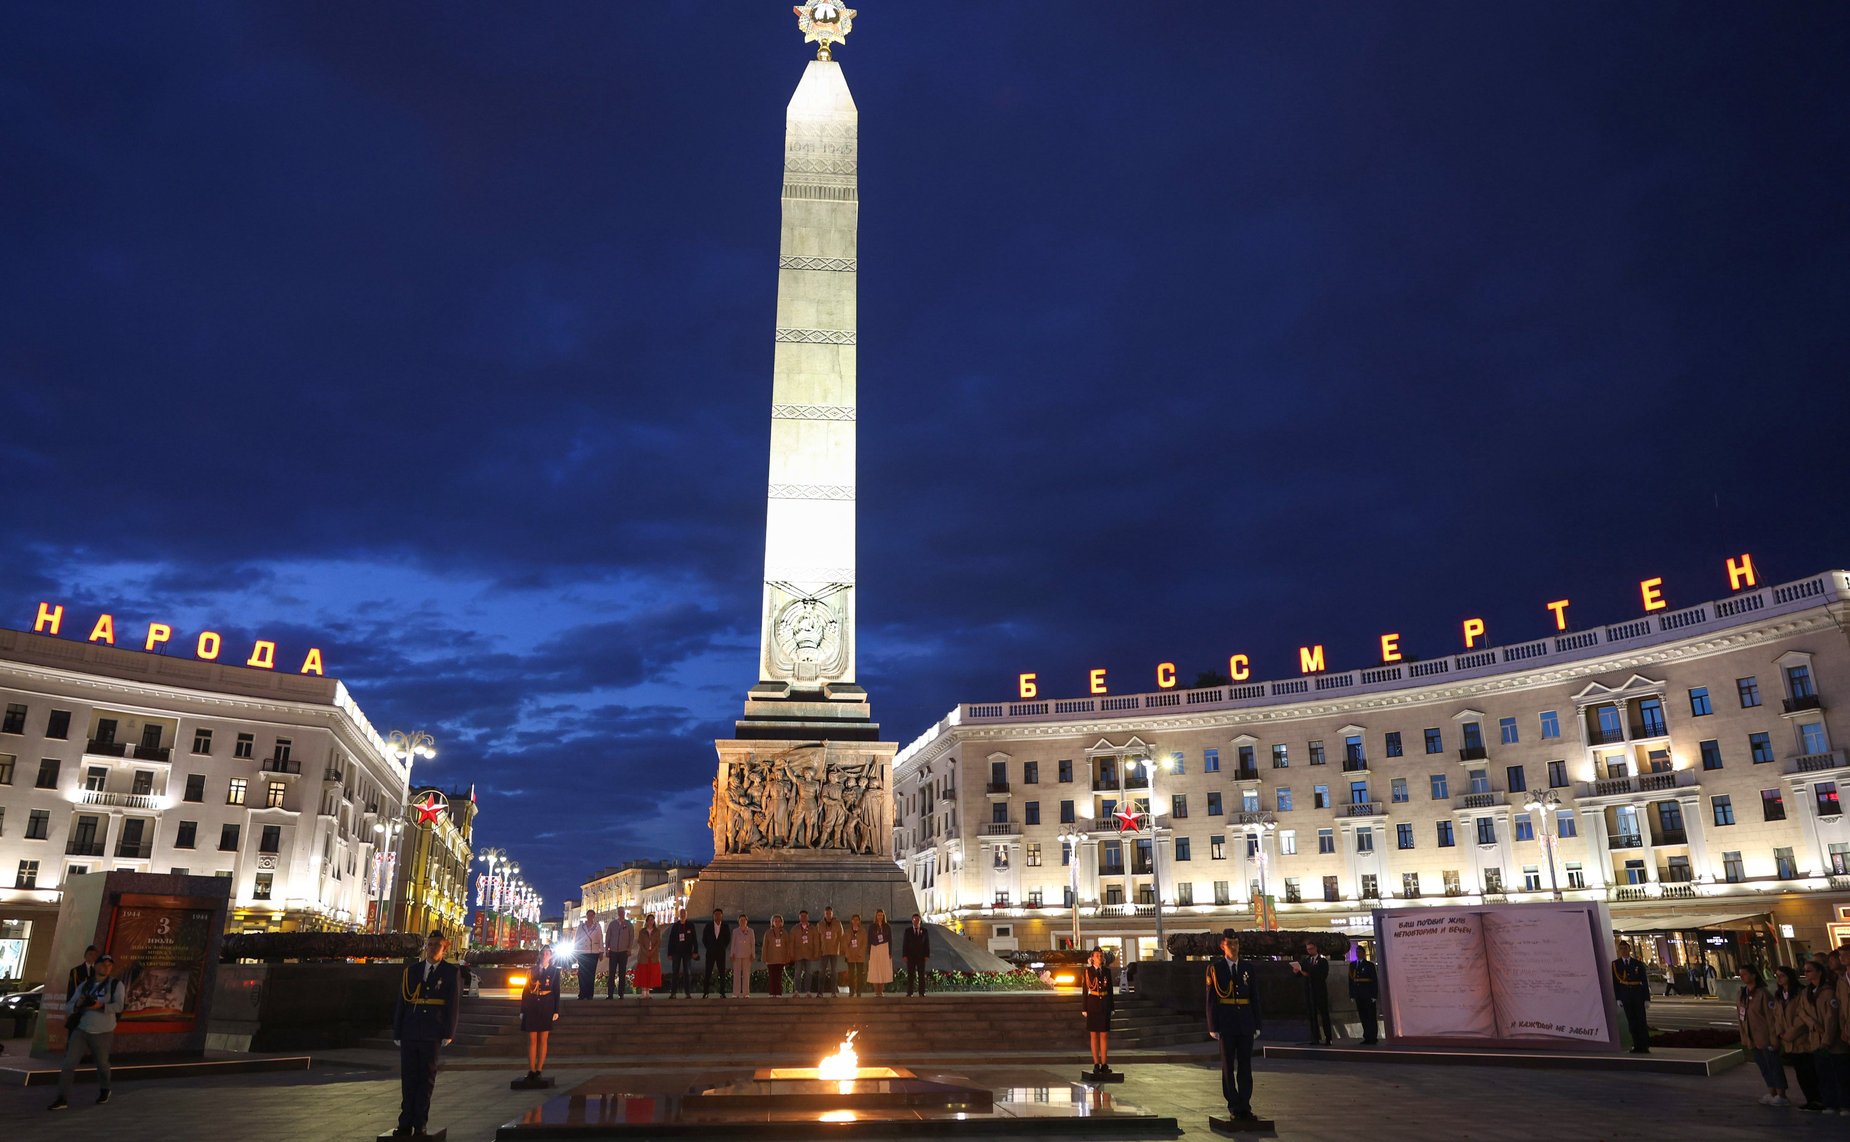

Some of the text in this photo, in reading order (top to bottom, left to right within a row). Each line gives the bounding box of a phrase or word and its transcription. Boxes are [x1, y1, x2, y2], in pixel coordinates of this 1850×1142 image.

[1018, 553, 1757, 699] БЕССМЕРТЕН
[34, 601, 325, 676] НАРОДА
[123, 911, 141, 919] 1944
[157, 917, 170, 935] 3
[1398, 921, 1415, 929] ВАШ
[1393, 927, 1438, 939] НЕПОВТОРИМ
[1555, 1025, 1567, 1033] НЕ
